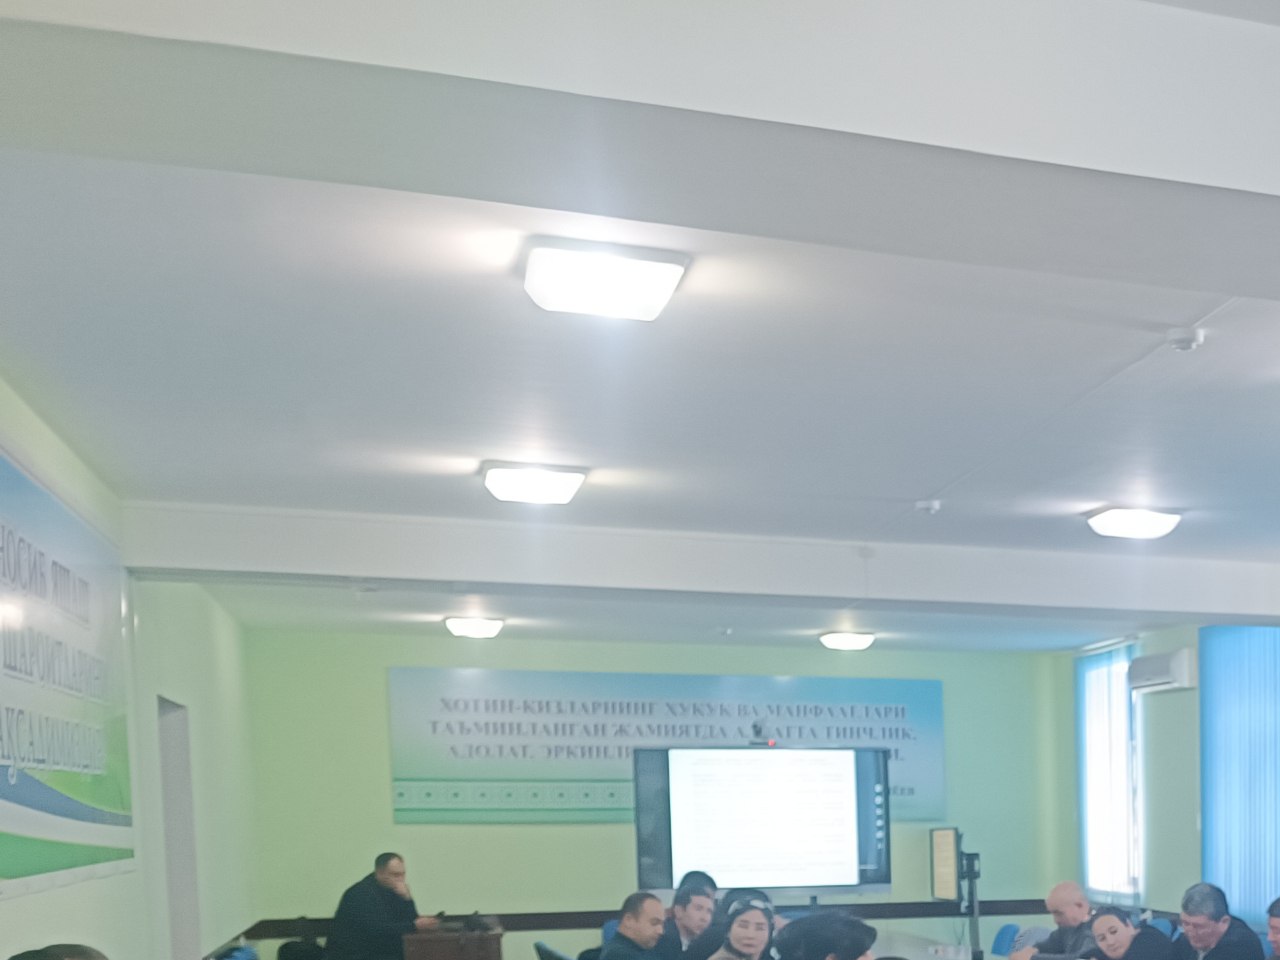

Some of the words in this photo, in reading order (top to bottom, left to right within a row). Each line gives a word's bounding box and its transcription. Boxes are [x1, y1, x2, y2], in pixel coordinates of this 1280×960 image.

[428, 720, 608, 737] ТАЪМИНЛАНГАН
[611, 723, 728, 741] ЖАМИЯТДА
[734, 725, 818, 741] ААТТА
